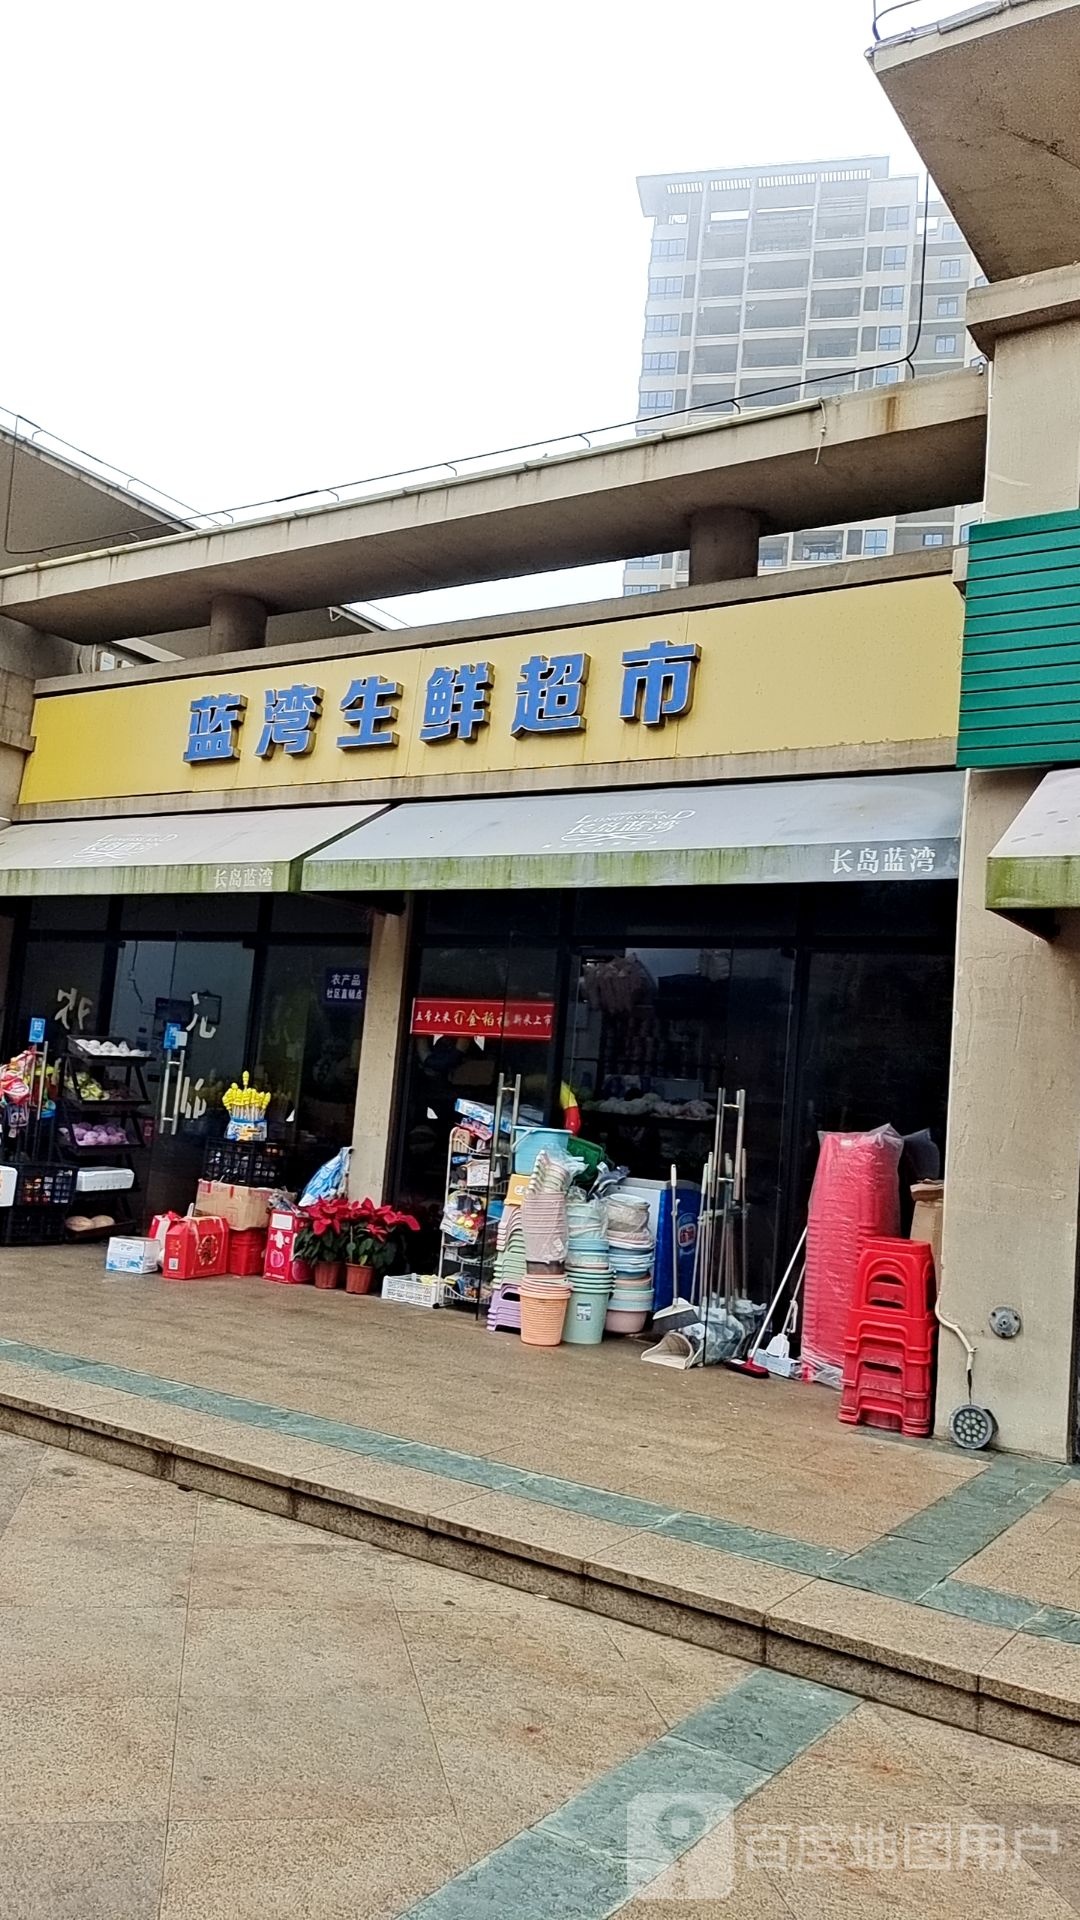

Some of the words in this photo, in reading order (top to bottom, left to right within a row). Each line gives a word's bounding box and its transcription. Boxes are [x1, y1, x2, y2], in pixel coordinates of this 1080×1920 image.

[183, 640, 701, 764] 蓝湾生鲜超市
[830, 846, 936, 874] 长岛蓝湾
[214, 867, 274, 889] 长岛蓝湾
[331, 973, 361, 986] 农产品
[326, 988, 363, 1000] 社区直销点
